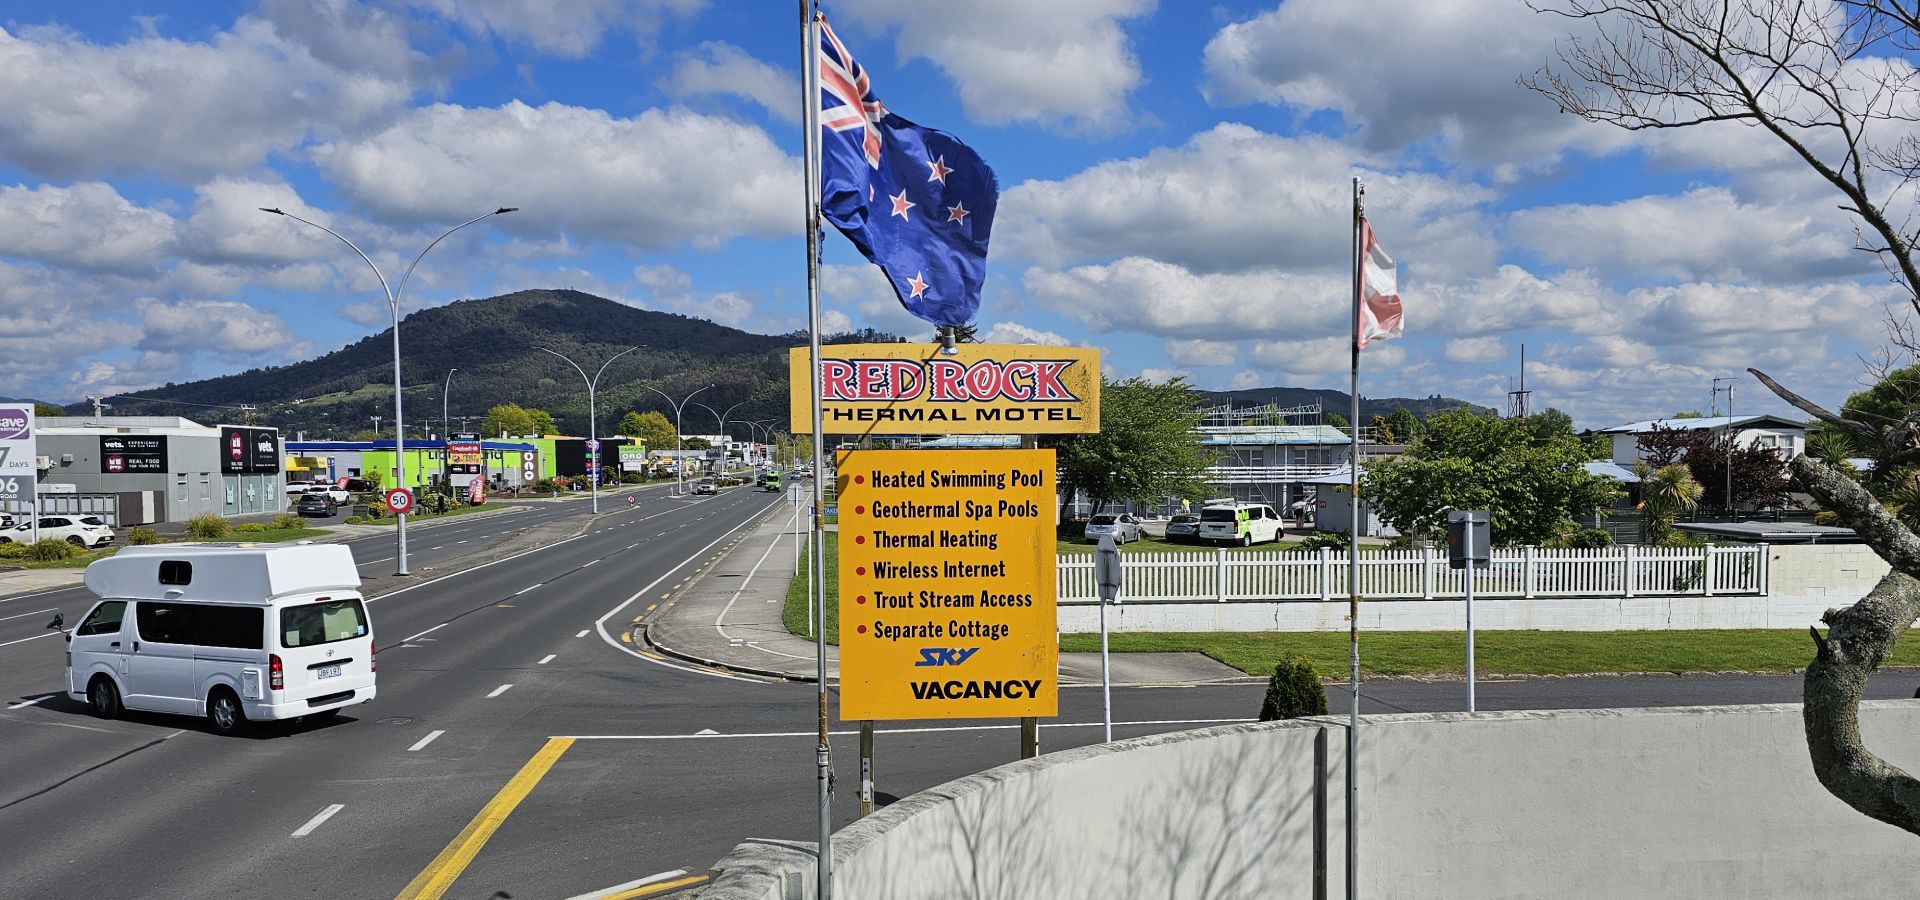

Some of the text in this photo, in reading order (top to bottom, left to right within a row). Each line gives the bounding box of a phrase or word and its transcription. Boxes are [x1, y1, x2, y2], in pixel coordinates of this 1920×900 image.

[821, 359, 1082, 402] RED ROCK
[0, 417, 25, 428] ave
[976, 408, 1082, 421] MOTEL
[872, 470, 1043, 490] Heated Swimming Pool
[392, 495, 406, 505] 50
[872, 500, 1039, 521] Geothermal Spa Pools
[873, 530, 998, 550] Thermal Heating
[873, 561, 1006, 578] Wireless Internet
[874, 590, 1032, 608] Trout Stream Access
[874, 620, 1009, 641] Separate Cottage
[914, 647, 980, 666] SKY
[911, 680, 1042, 699] VACANCY
